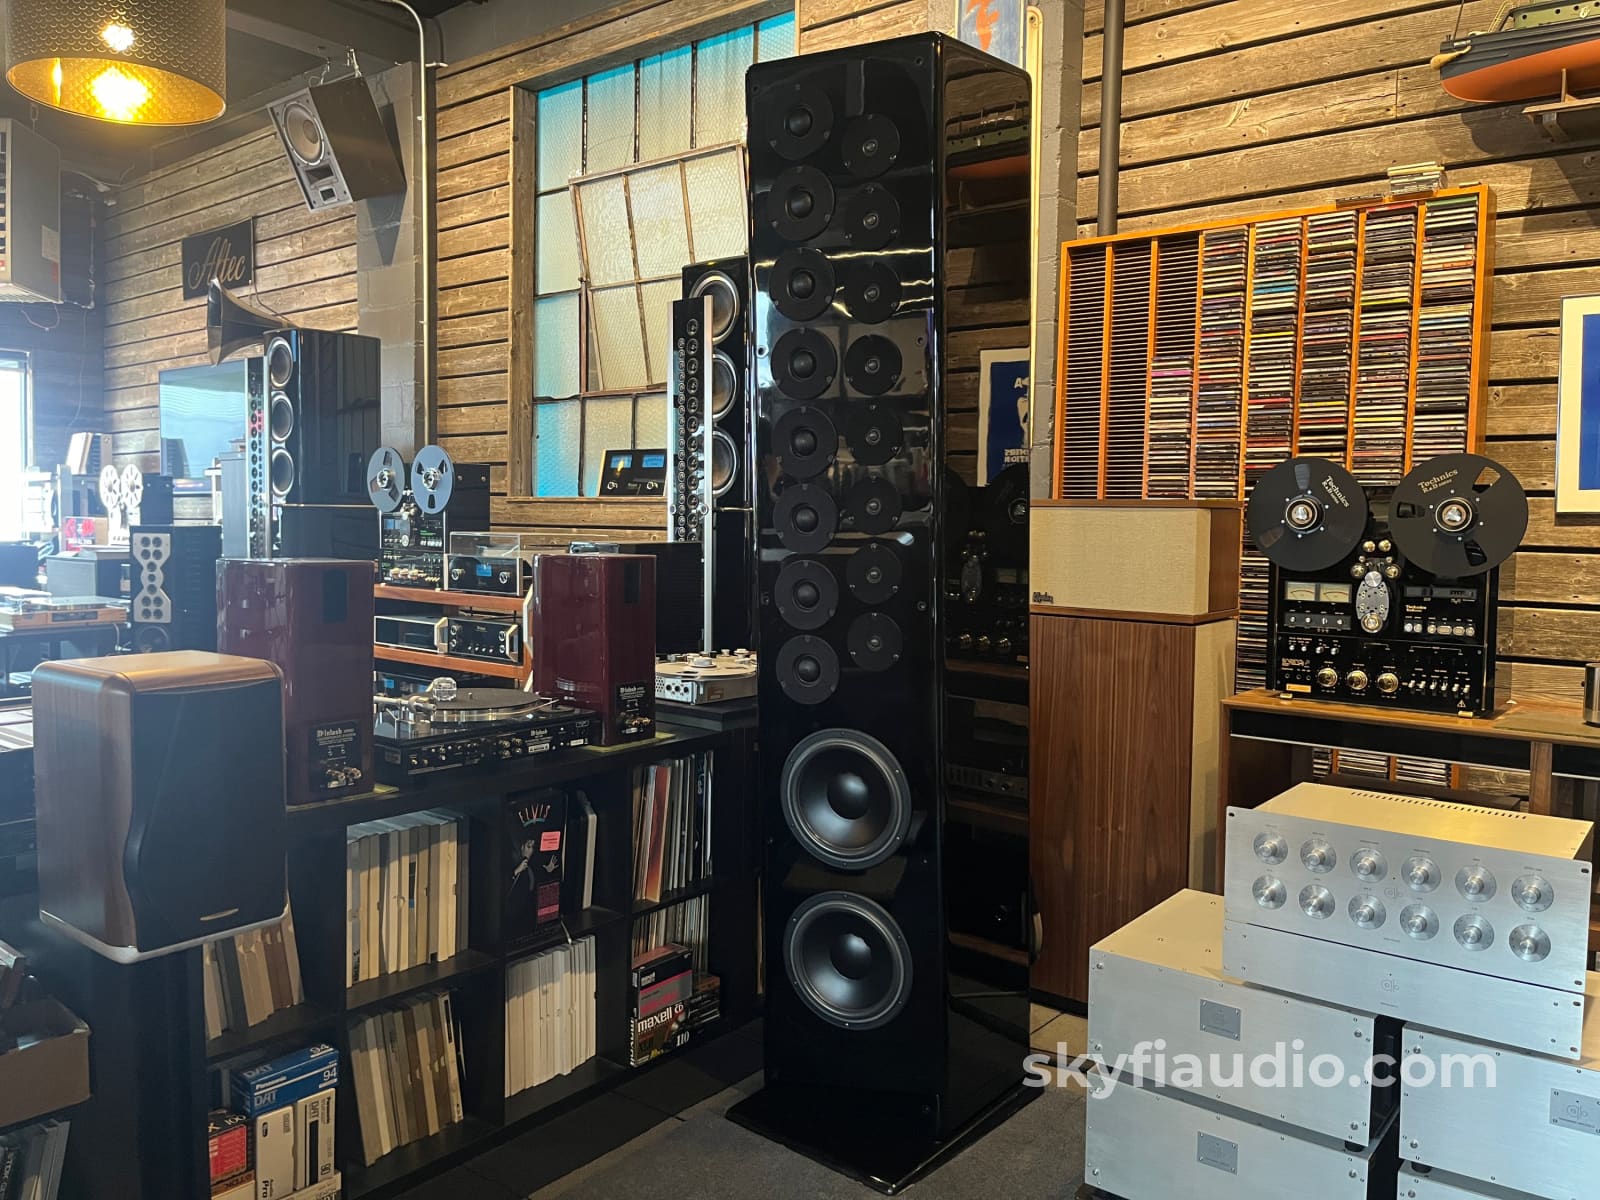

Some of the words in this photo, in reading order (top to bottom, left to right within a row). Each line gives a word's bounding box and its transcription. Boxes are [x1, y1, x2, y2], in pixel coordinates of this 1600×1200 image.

[188, 236, 246, 290] Altec
[1326, 475, 1350, 508] Technics
[1417, 469, 1459, 489] Technics
[518, 803, 551, 825] ELVIS
[637, 1006, 672, 1033] maxell
[676, 1031, 690, 1047] 110
[254, 1090, 278, 1107] DAT
[323, 1067, 337, 1081] 94
